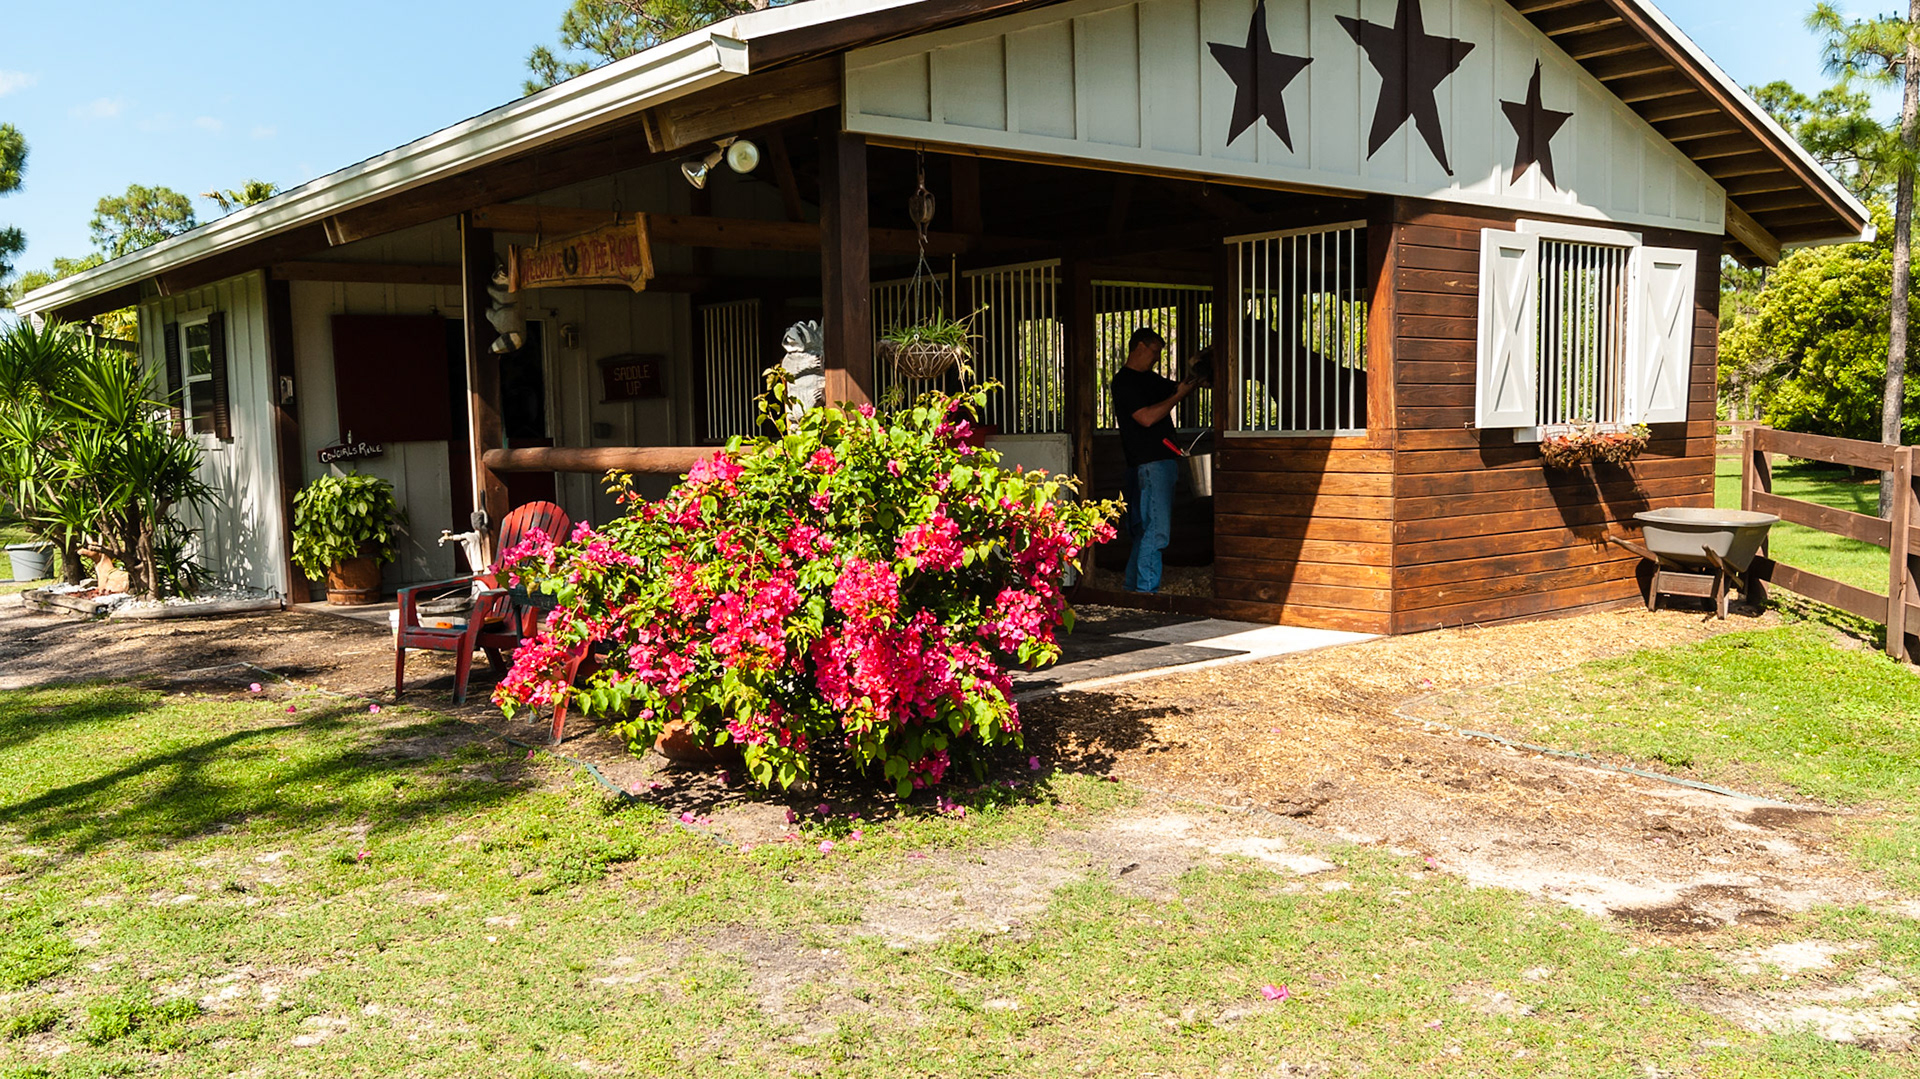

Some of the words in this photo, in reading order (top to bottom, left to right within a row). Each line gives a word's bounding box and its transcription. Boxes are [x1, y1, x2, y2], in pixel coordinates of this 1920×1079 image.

[576, 240, 592, 276] TO
[613, 364, 651, 381] SADDLE
[626, 380, 641, 396] UP
